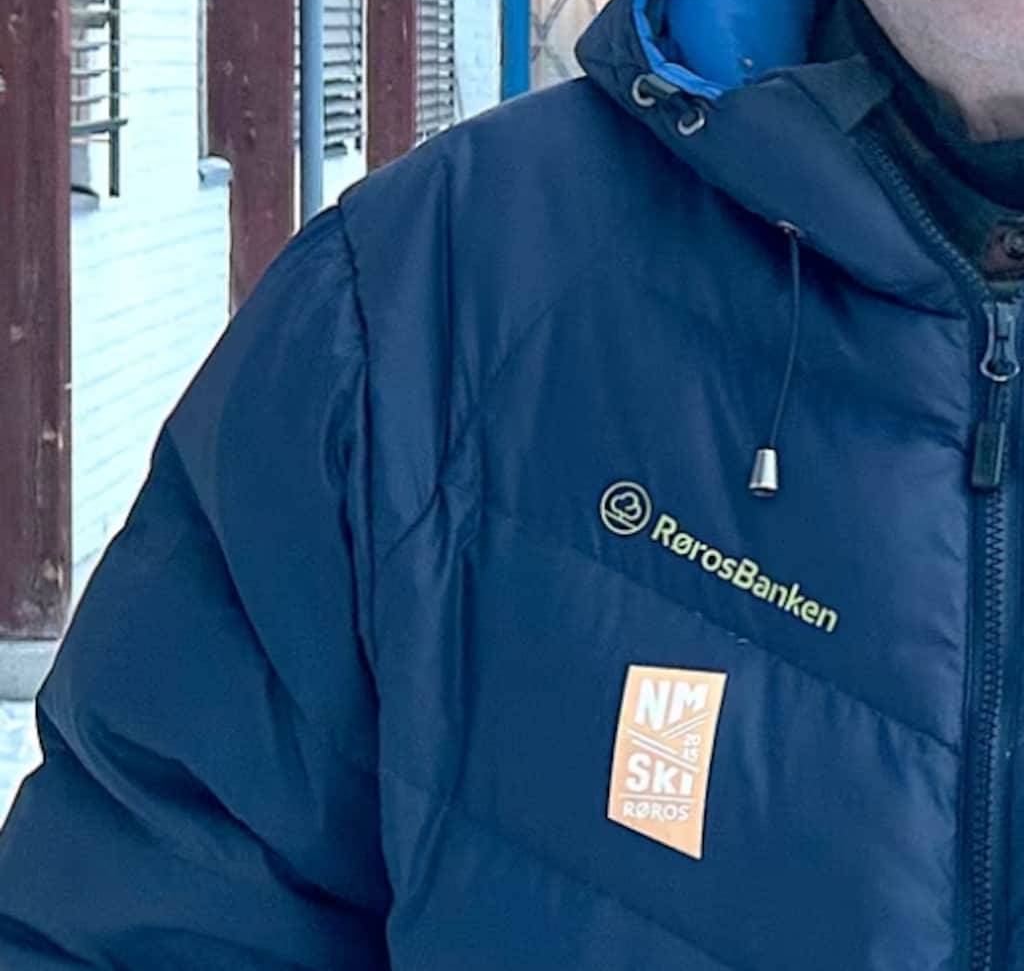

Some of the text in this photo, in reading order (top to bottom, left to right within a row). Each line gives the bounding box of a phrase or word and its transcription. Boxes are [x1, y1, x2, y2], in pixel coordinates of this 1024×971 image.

[651, 514, 838, 632] RørosBanken
[634, 678, 709, 731] NM
[623, 800, 689, 821] RØROS
